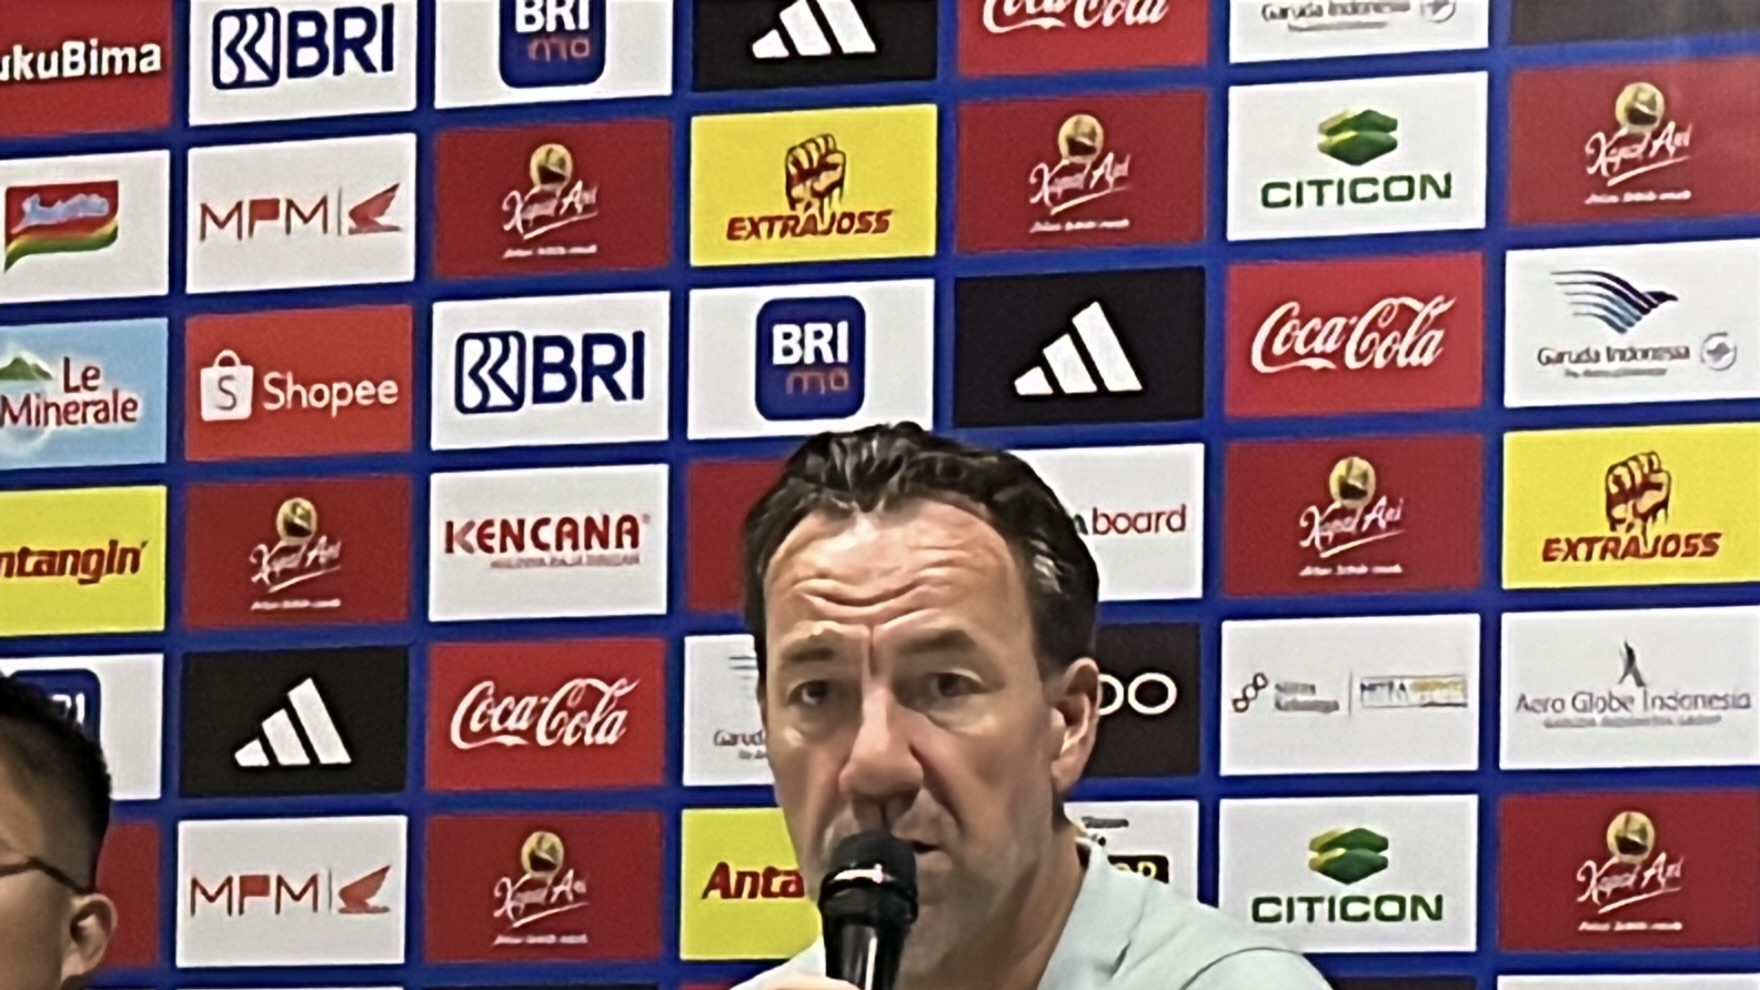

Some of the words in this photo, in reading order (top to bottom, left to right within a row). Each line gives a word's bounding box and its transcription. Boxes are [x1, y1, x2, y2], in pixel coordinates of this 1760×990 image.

[515, 0, 590, 32] BRI
[288, 4, 394, 78] BRI
[1261, 172, 1453, 209] CITICON
[200, 194, 329, 242] MPM
[726, 209, 895, 241] EXTRAJOSS
[771, 321, 849, 366] BRI
[1252, 295, 1456, 374] Coca-Cola
[63, 356, 101, 394] Le
[533, 331, 646, 403] BRI
[0, 387, 138, 428] Minerale
[262, 371, 399, 417] Shopee
[444, 513, 641, 554] KENCANA
[1075, 503, 1187, 537] board
[1541, 531, 1722, 563] EXTRAJOSS
[450, 678, 639, 750] Coca-Cola
[190, 875, 319, 918] MPM
[702, 862, 805, 900] Anta
[1252, 894, 1444, 923] CITICON
